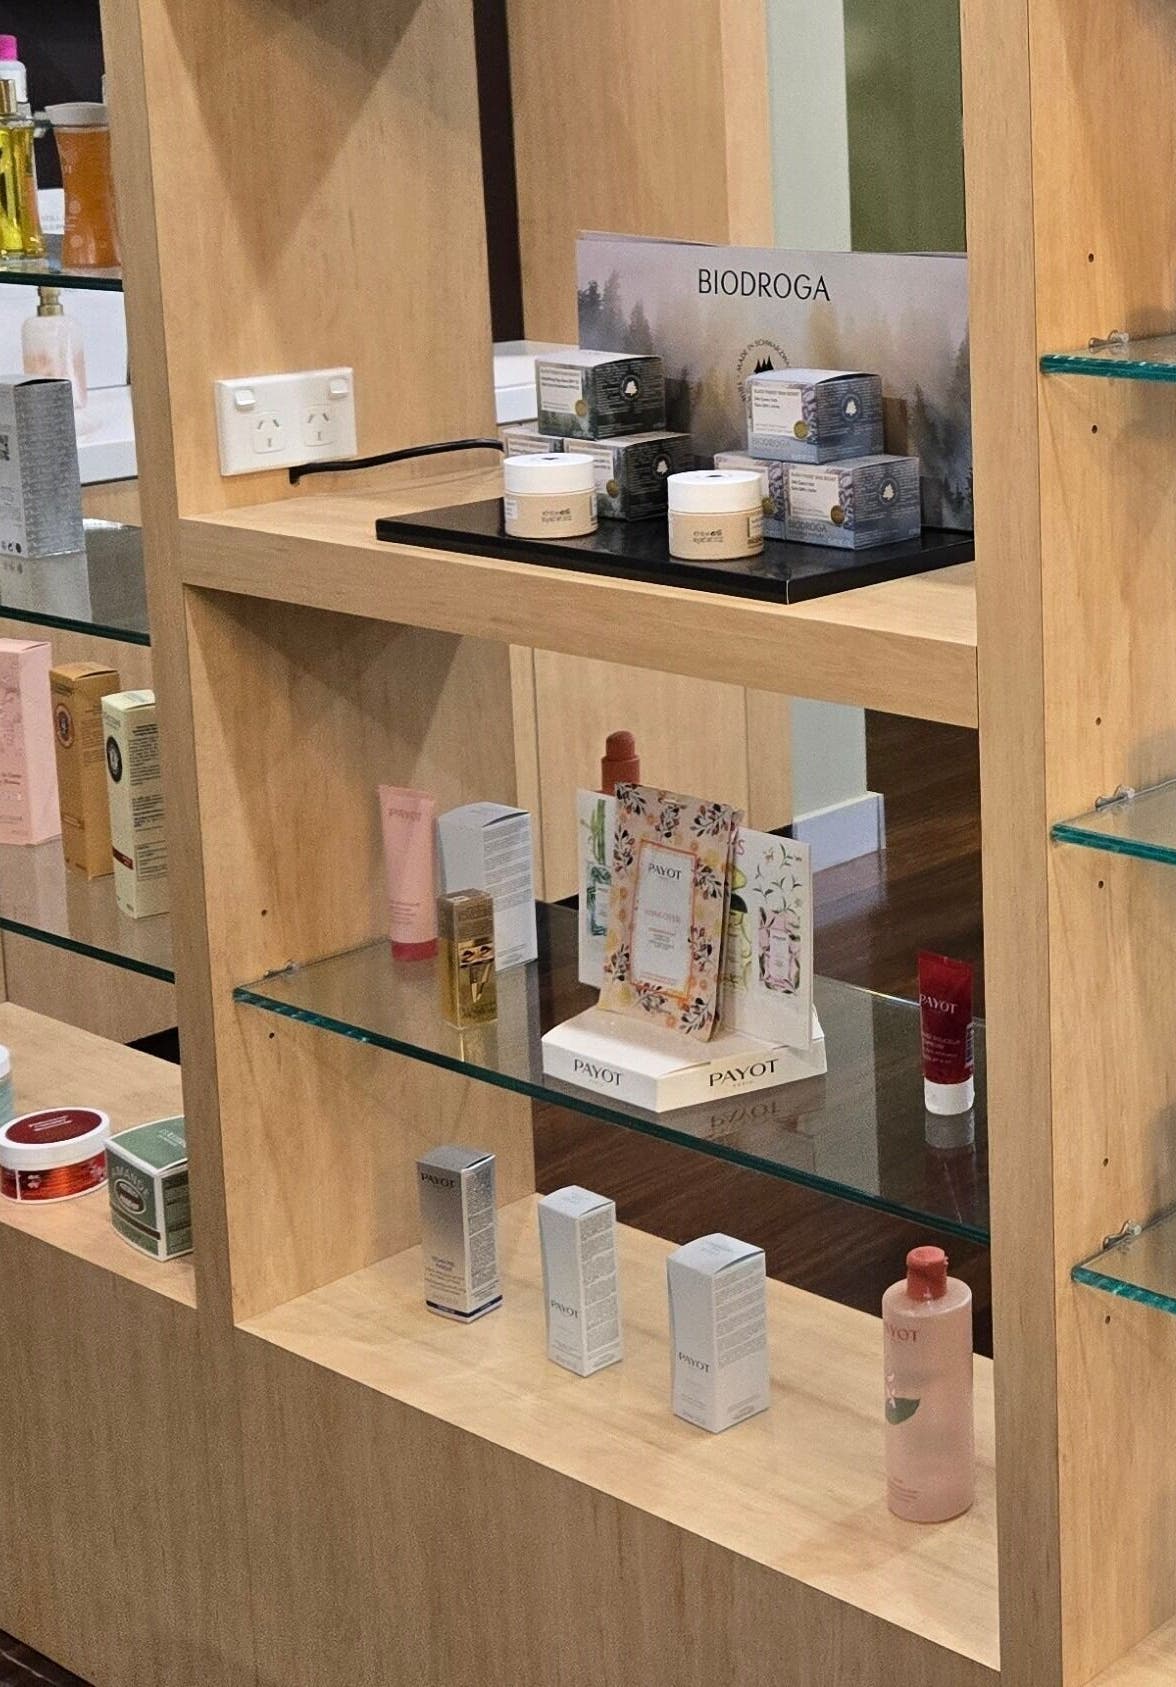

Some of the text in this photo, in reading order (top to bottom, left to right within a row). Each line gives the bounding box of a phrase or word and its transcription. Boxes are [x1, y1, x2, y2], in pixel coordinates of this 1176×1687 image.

[699, 268, 831, 302] BIODROGA
[648, 863, 682, 880] PAYOT
[920, 993, 958, 1014] PAYOT
[574, 1059, 622, 1085] PAYOT
[709, 1058, 779, 1087] PAYOT
[420, 1172, 457, 1188] PAYOT
[551, 1300, 578, 1318] PAYOT
[678, 1351, 711, 1374] PAYOT
